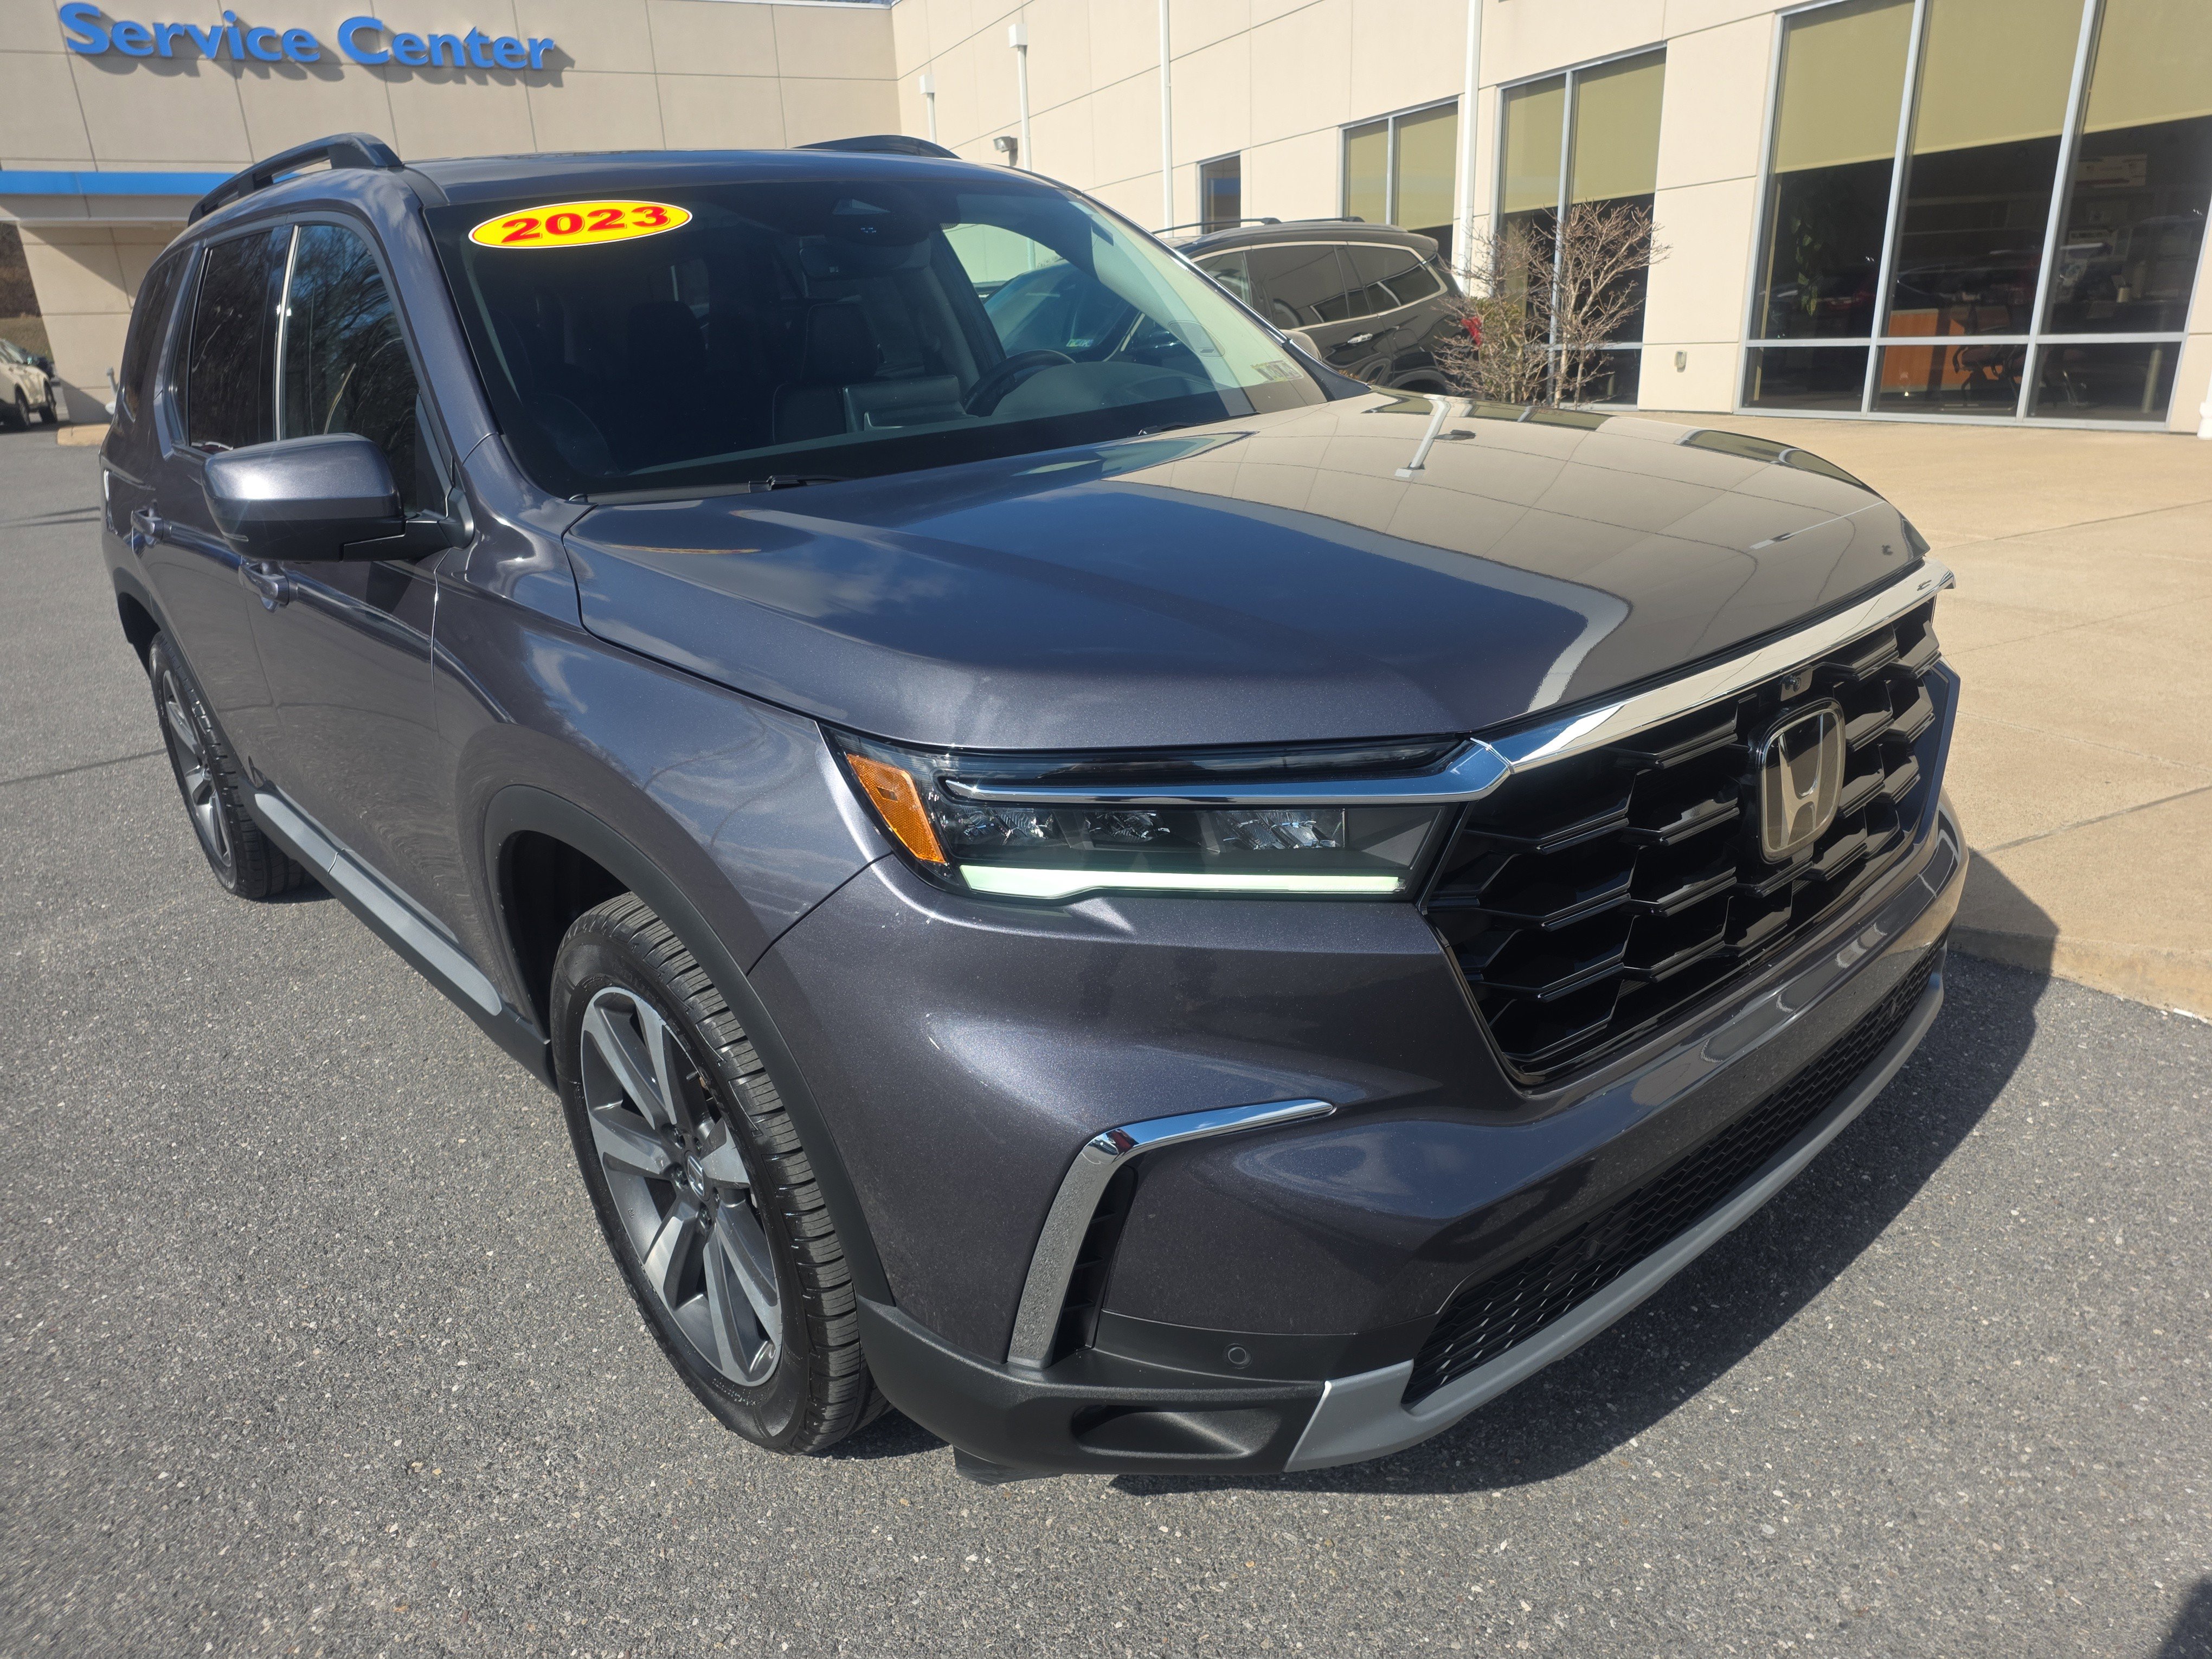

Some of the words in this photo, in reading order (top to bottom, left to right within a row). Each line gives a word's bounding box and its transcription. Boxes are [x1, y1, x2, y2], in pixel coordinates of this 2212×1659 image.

[60, 3, 319, 62] Service
[338, 16, 554, 70] Center
[501, 206, 671, 243] 2023
